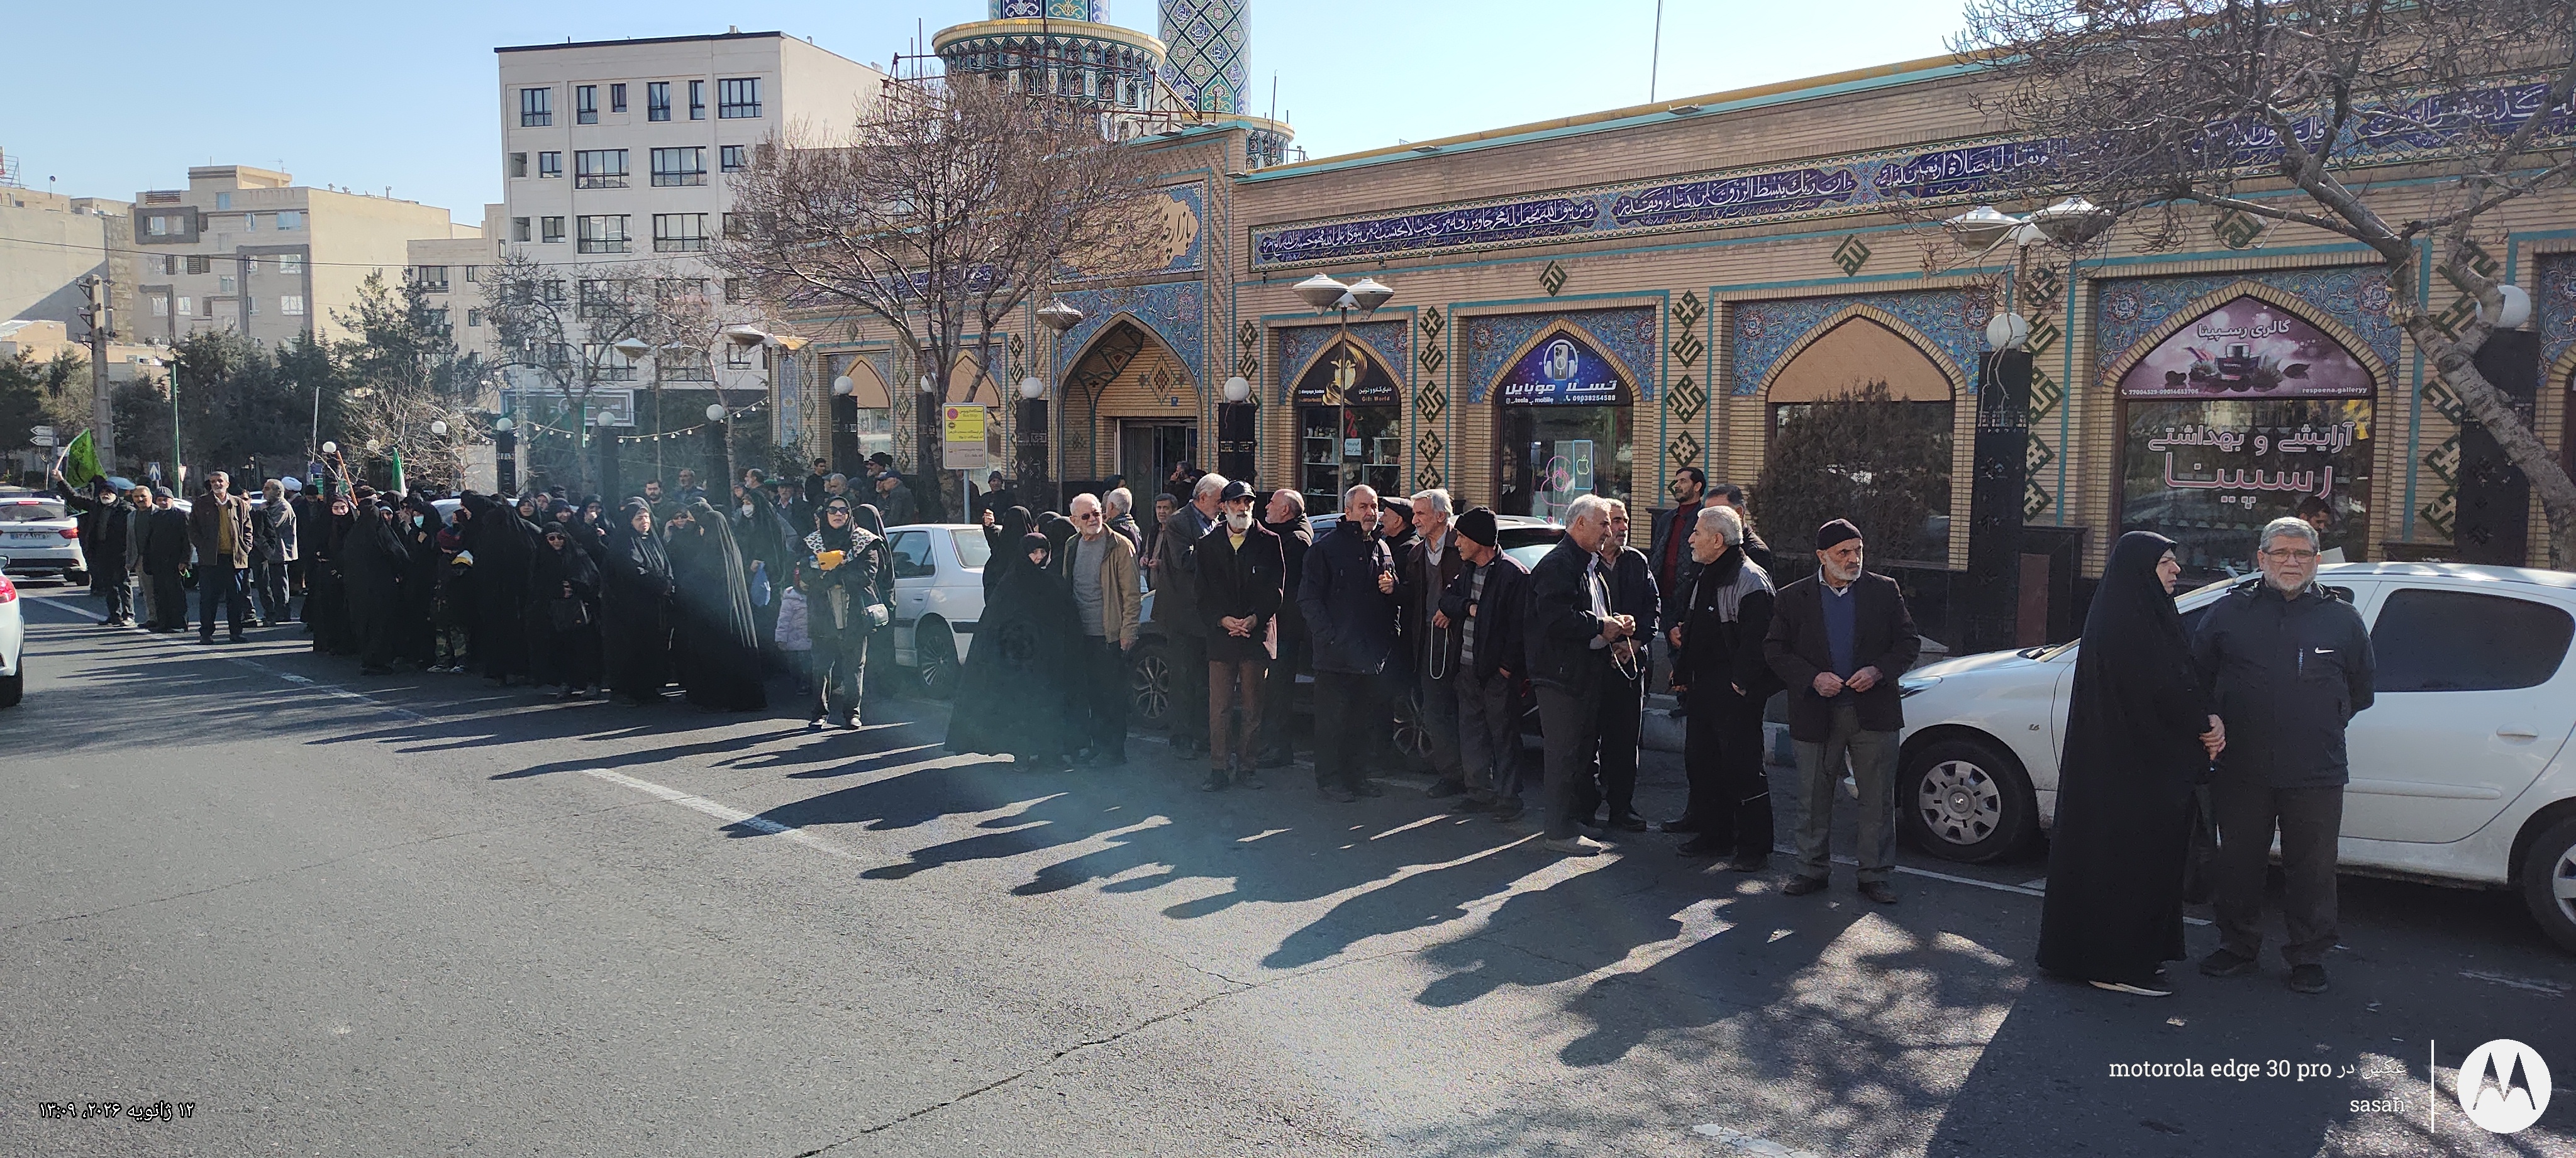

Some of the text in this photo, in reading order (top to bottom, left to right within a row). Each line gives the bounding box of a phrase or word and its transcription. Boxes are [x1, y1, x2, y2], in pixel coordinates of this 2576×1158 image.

[2197, 319, 2291, 341] گالری رسپینا
[1505, 380, 1618, 395] تسلا موبایل
[2148, 421, 2357, 456] آرایشی و بهداشتی
[2164, 451, 2333, 510] رسپینا
